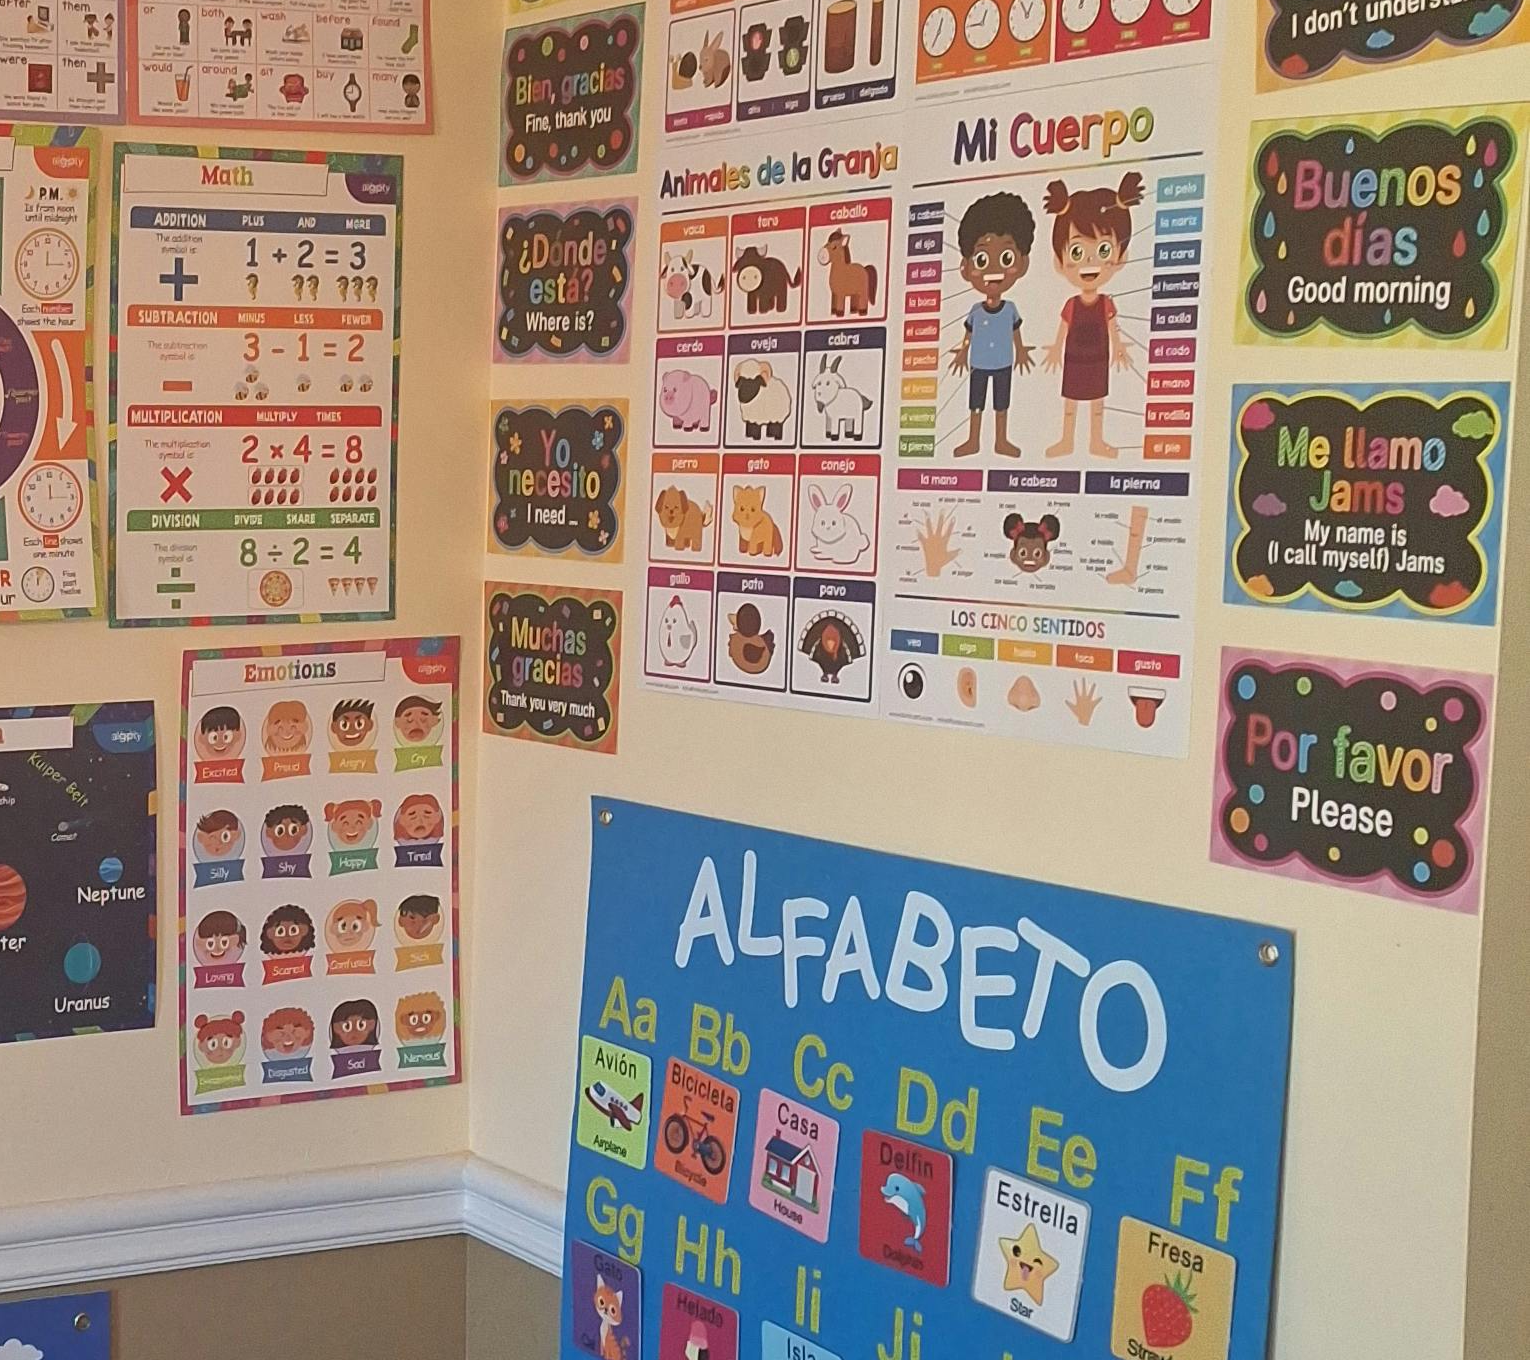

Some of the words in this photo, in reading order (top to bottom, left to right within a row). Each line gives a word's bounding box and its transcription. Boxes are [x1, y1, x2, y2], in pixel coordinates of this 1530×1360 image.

[515, 74, 556, 106] Bien,
[561, 62, 625, 104] gracias
[954, 118, 998, 165] Mi
[1010, 106, 1154, 158] Cuerpo
[202, 165, 254, 186] Math
[660, 160, 751, 199] Animales
[757, 155, 786, 187] de
[791, 151, 811, 181] la
[818, 144, 899, 184] Granja
[1293, 158, 1462, 211] Buenos
[154, 212, 206, 226] ADDITION
[831, 206, 868, 220] caballo
[519, 230, 606, 274] ¿Dónde
[1322, 212, 1418, 267] días
[529, 264, 594, 304] está?
[1287, 275, 1347, 304] Good
[1354, 276, 1452, 309] morning
[138, 310, 218, 324] SUBTRACTION
[132, 410, 222, 423] MULTIPLICATION
[539, 429, 571, 468] Yo
[820, 458, 856, 473] conejo
[1278, 425, 1330, 470] Me
[1343, 427, 1446, 471] llamo
[509, 462, 600, 499] necesito
[1309, 470, 1406, 515] Jams
[152, 514, 200, 528] DIVISION
[511, 616, 587, 655] Muchas
[951, 610, 976, 628] LOS
[981, 612, 1027, 632] CINCO
[1033, 619, 1105, 639] SENTIDOS
[244, 660, 337, 683] Emotions
[512, 654, 582, 688] gracias
[1245, 713, 1318, 773] Por
[1333, 725, 1453, 794] favor
[1291, 786, 1393, 837] Please
[77, 885, 145, 905] Neptune
[205, 970, 234, 984] Loving
[674, 849, 1167, 1092] ALFABETO
[54, 995, 110, 1013] Uranus
[599, 975, 658, 1043] Aa
[689, 1003, 751, 1076] Bb
[595, 1046, 638, 1080] Avión
[671, 1063, 735, 1113] Bicicleta
[777, 1102, 820, 1141] Casa
[997, 1181, 1079, 1235] Estrella
[1148, 1233, 1205, 1273] Fresa
